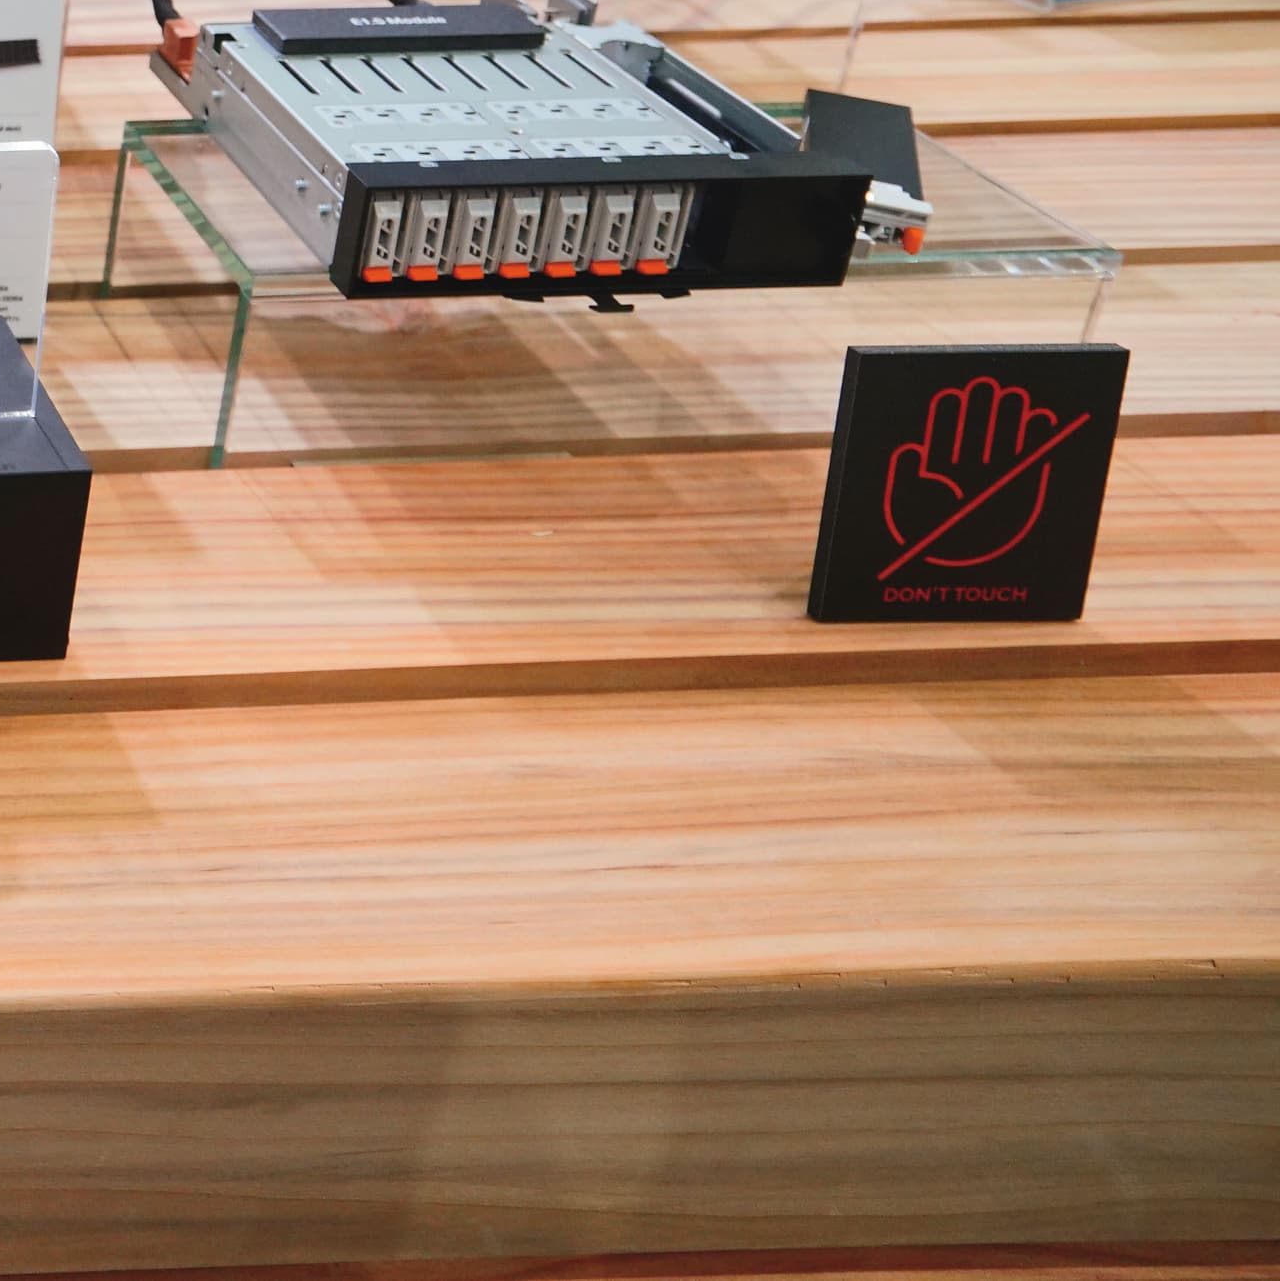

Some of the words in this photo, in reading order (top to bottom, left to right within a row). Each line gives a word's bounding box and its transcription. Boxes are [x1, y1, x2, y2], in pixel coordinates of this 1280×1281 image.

[386, 16, 448, 25] Module
[883, 586, 949, 603] DON'T
[955, 586, 1028, 603] TOUCH
